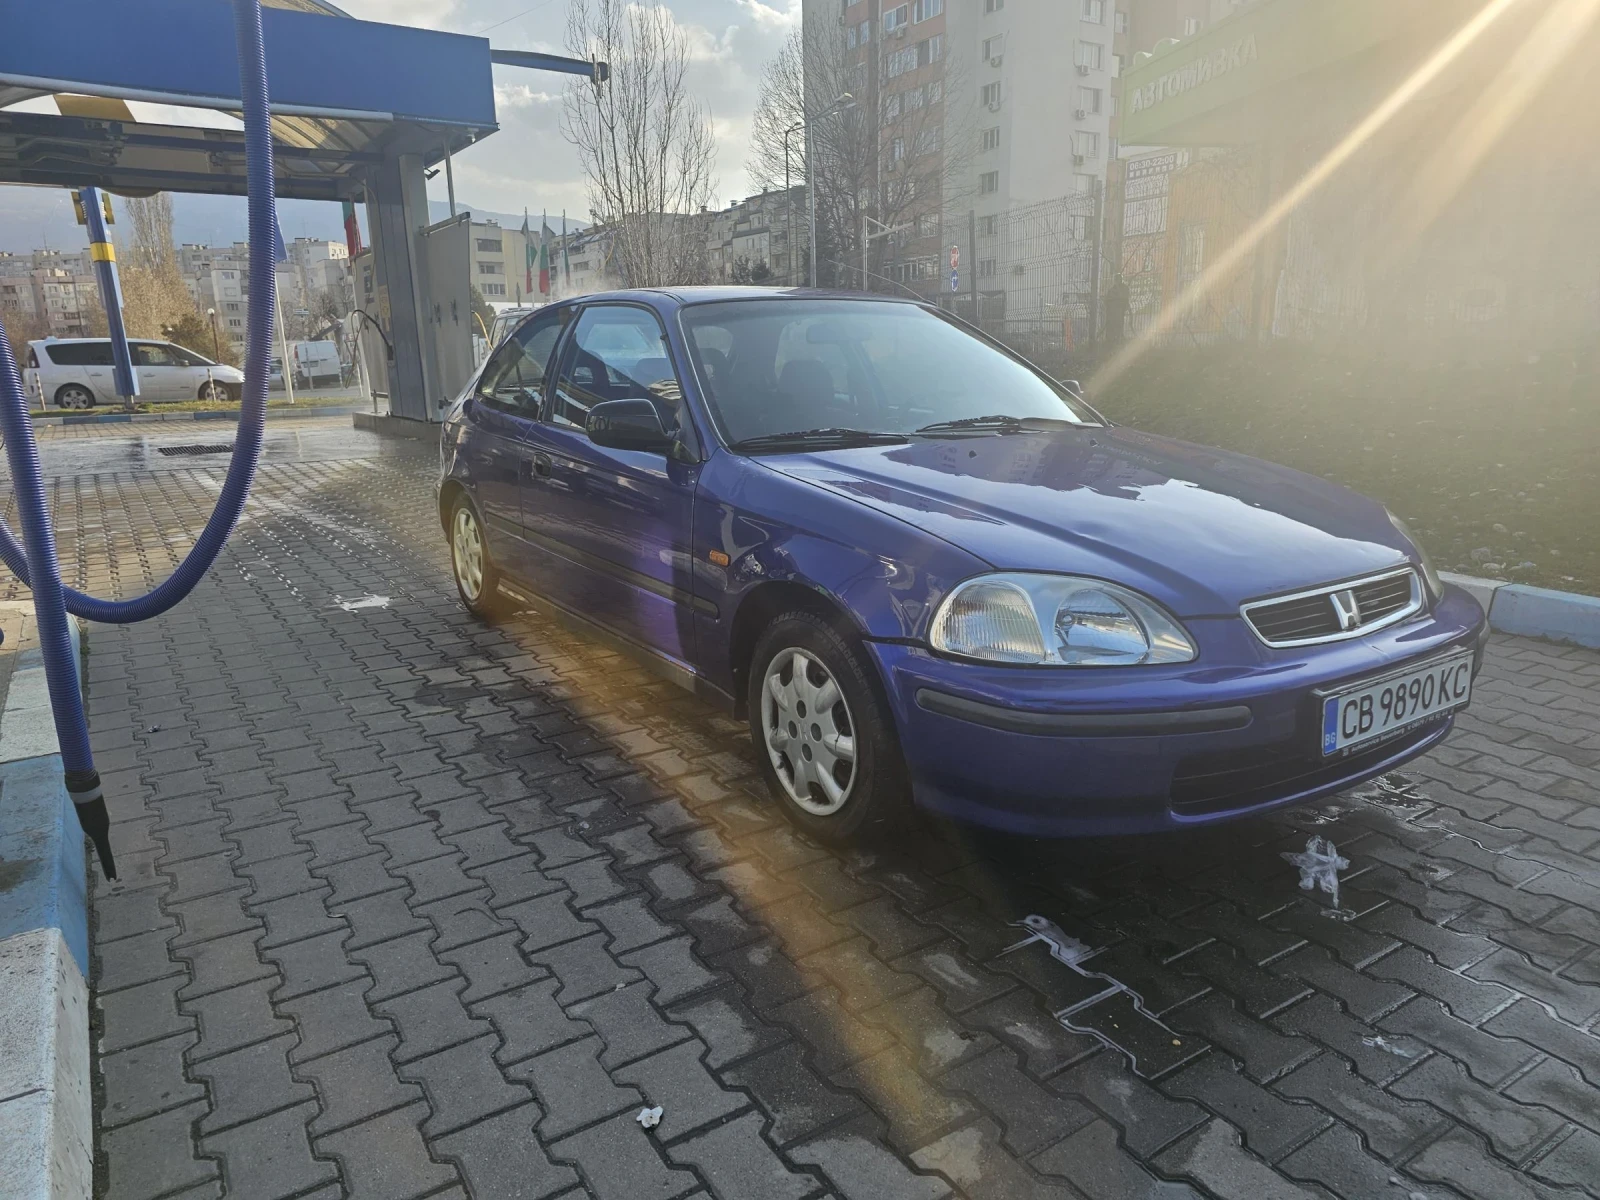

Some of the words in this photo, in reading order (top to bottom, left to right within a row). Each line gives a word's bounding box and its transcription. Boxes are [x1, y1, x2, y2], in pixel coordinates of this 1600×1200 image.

[1131, 33, 1258, 114] АВТОМИВКА
[1324, 732, 1336, 747] BG
[1342, 693, 1374, 740] CB
[1380, 673, 1435, 727] 9890
[1438, 662, 1469, 706] KC
